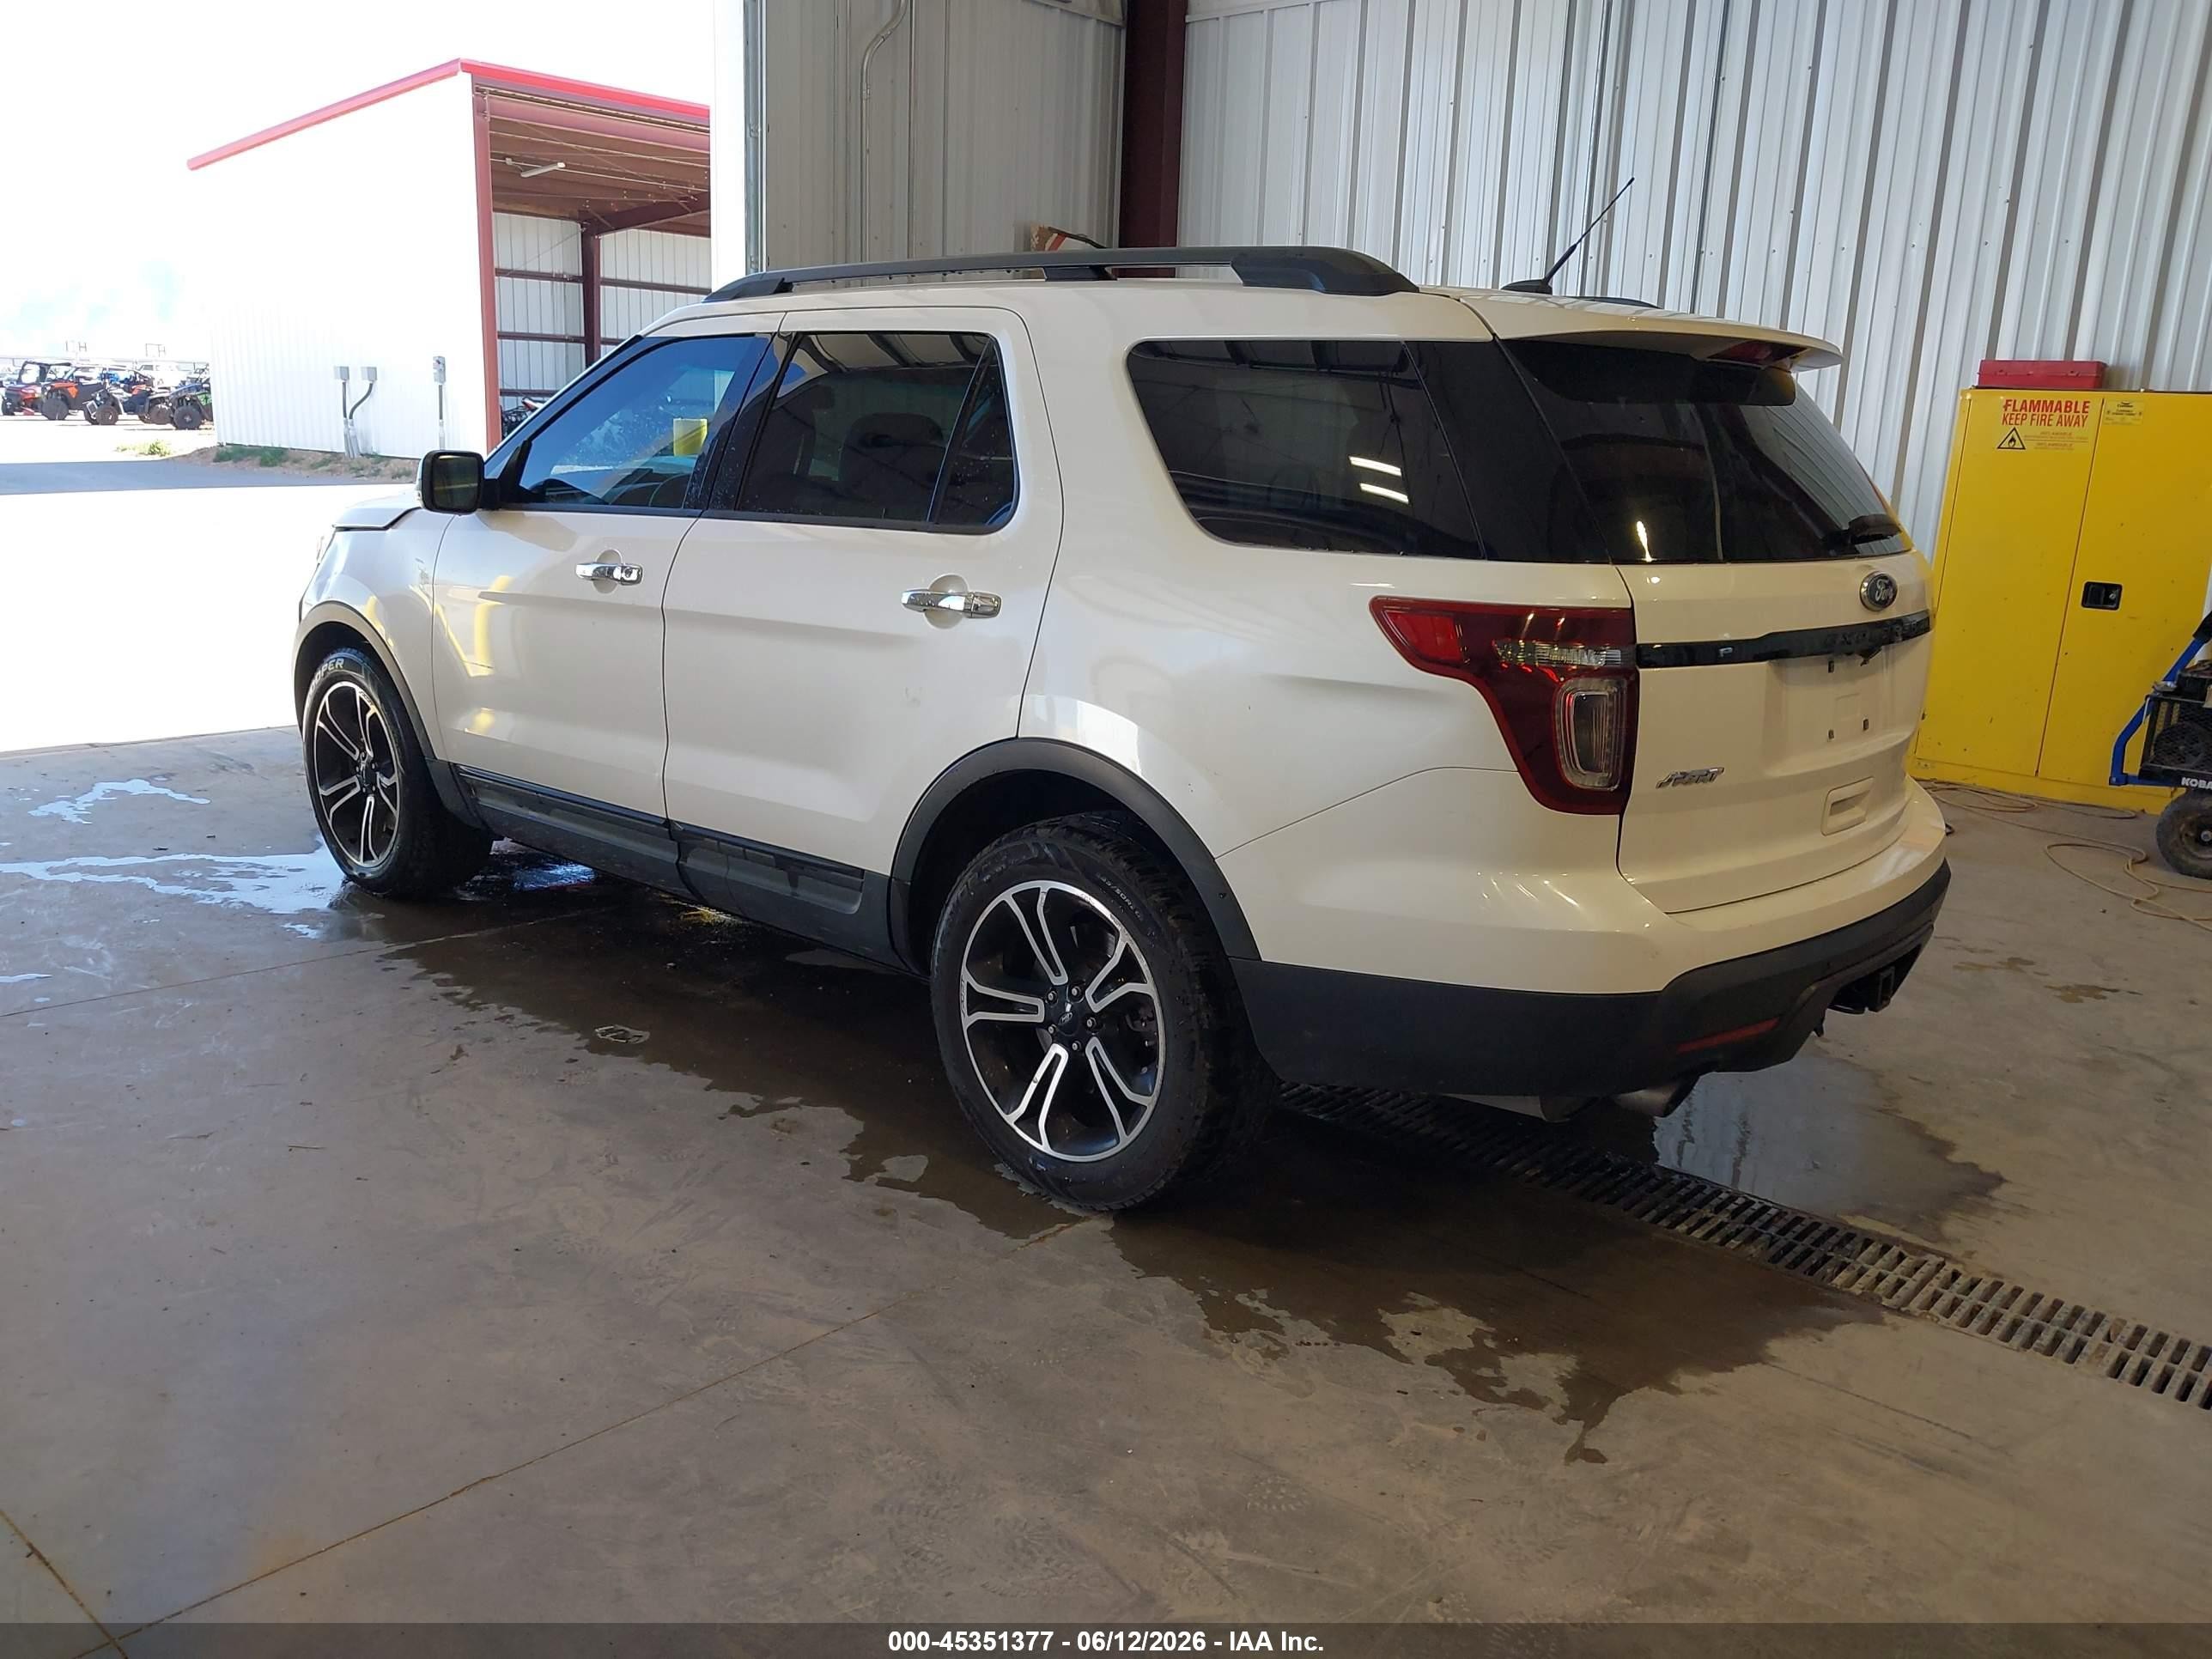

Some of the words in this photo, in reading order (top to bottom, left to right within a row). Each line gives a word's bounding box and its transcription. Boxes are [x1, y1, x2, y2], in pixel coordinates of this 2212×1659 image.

[2002, 399, 2091, 414] FLAMMABLE
[2002, 413, 2027, 426] KEEP
[2030, 414, 2054, 427] FIRE
[2056, 415, 2089, 428] AWAY
